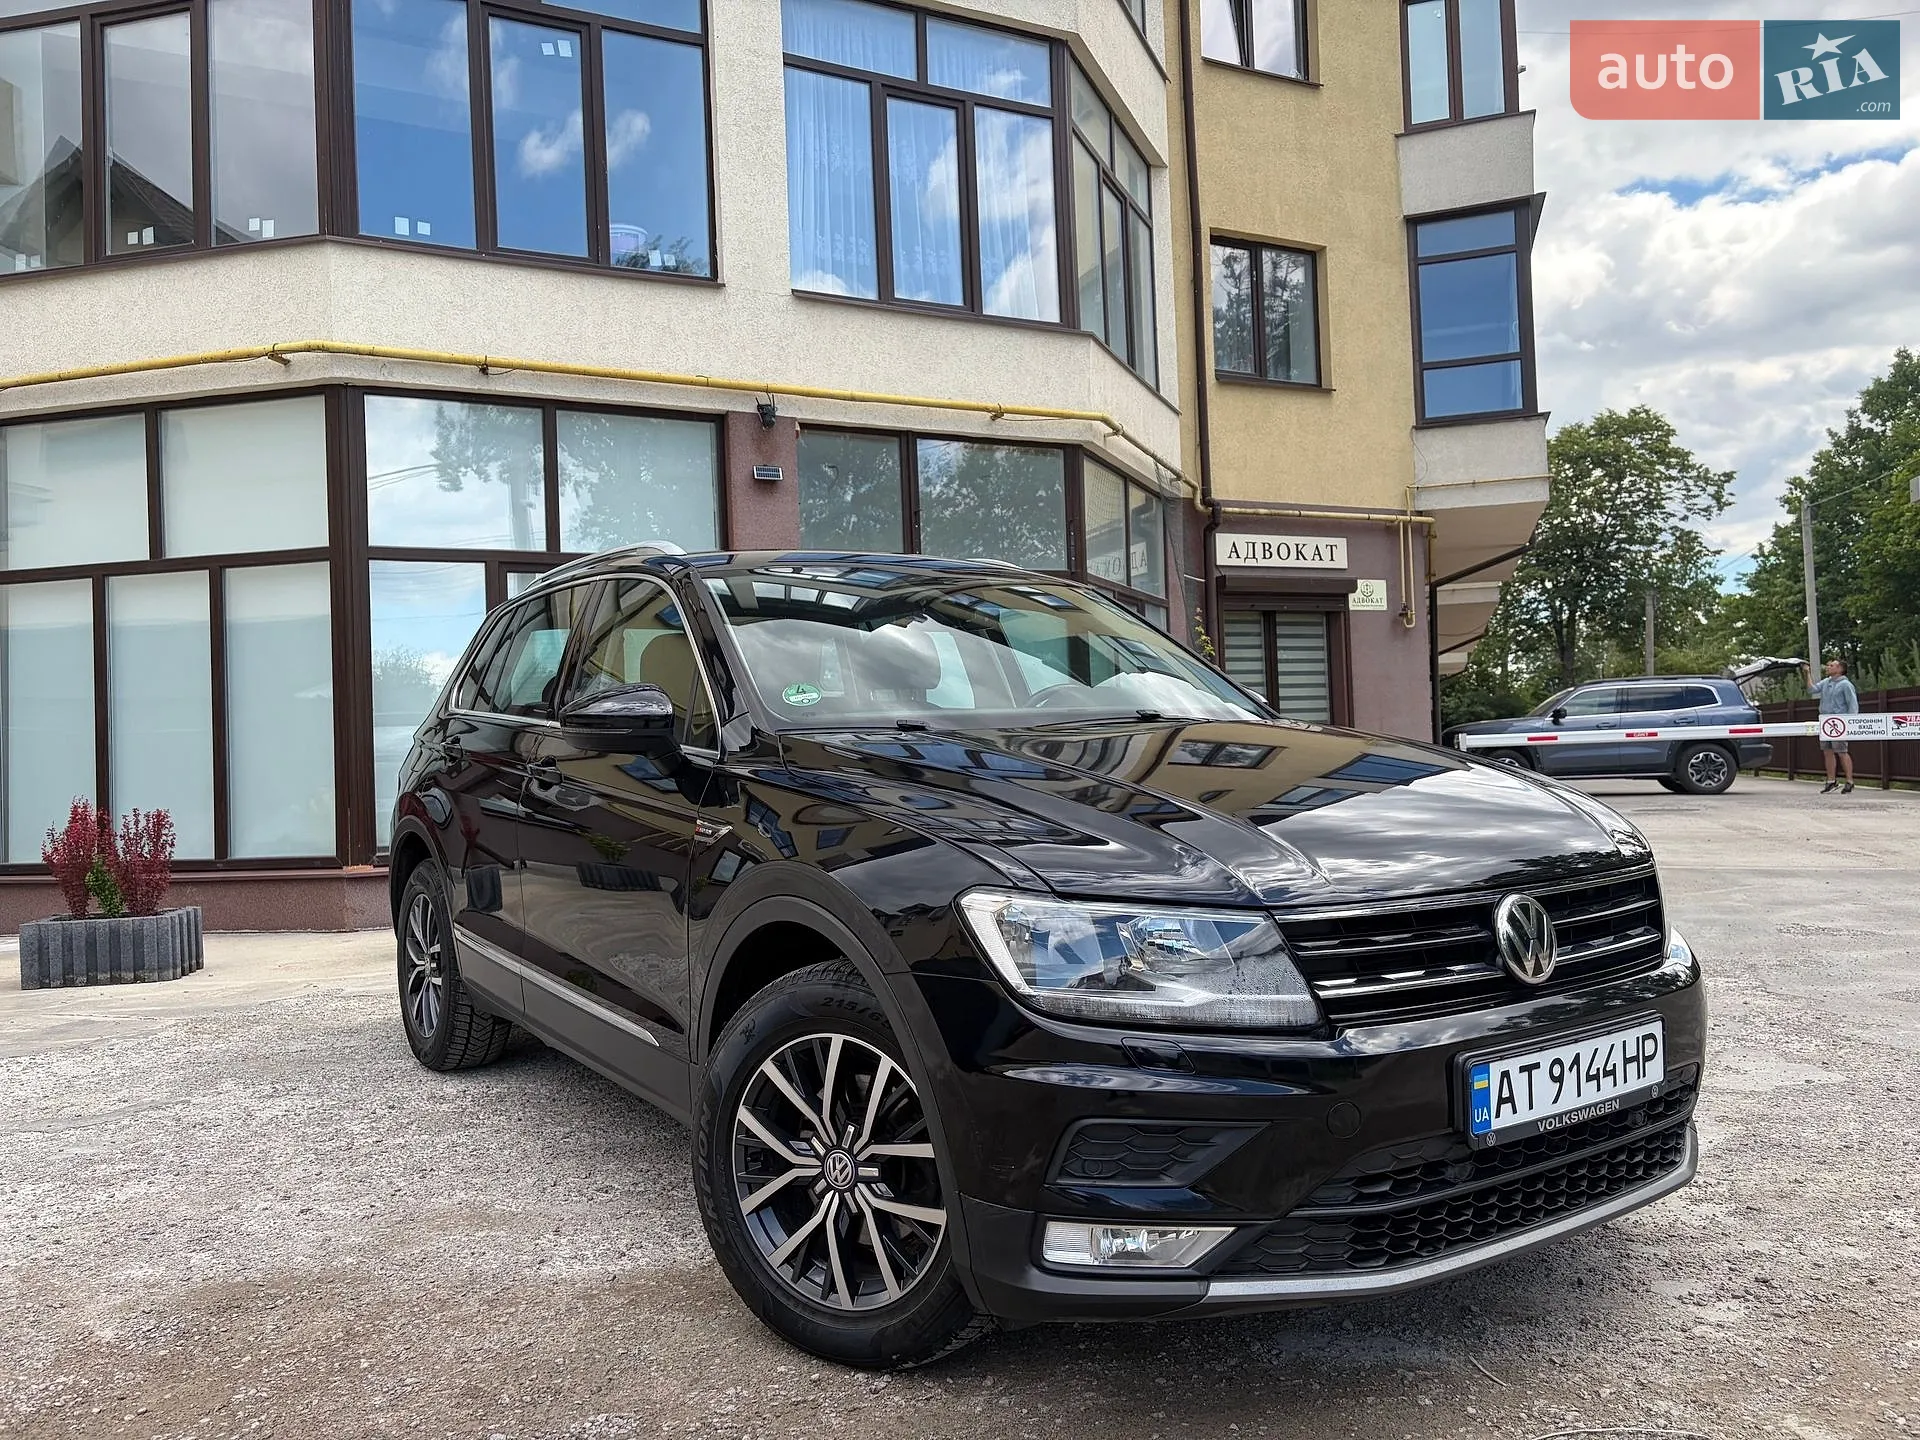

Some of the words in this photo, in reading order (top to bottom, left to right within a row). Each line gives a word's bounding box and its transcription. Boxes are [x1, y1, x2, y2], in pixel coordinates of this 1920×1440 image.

[1227, 541, 1338, 564] АДВОКАТ
[1494, 1062, 1541, 1119] AT
[1549, 1043, 1617, 1105] 9144
[1622, 1032, 1659, 1084] HP
[1474, 1107, 1490, 1123] UA
[1537, 1099, 1620, 1132] VOLKSWAGEN
